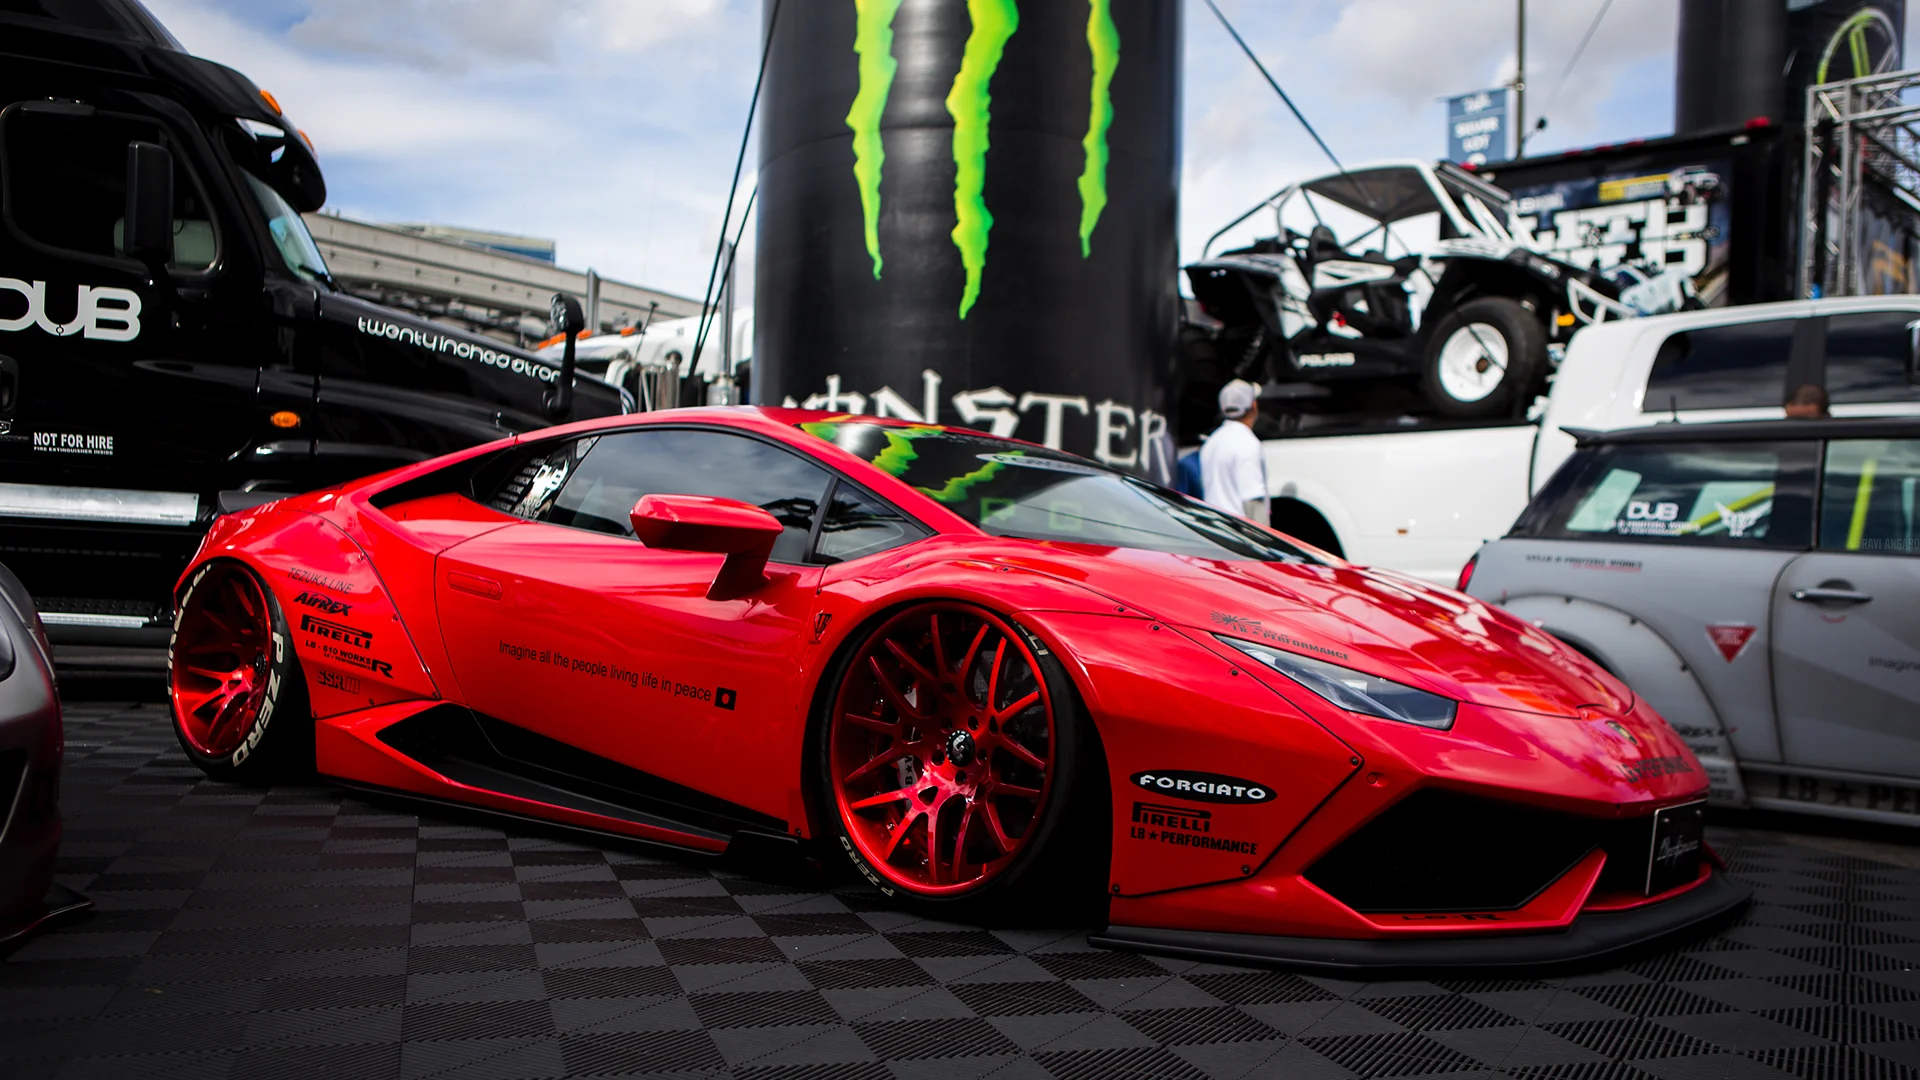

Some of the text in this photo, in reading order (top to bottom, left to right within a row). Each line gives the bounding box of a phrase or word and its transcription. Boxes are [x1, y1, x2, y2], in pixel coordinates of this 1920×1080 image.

[0, 276, 141, 342] DUB
[357, 316, 437, 351] twenty
[33, 432, 113, 450] NOT FOR HIRE
[1626, 501, 1679, 520] DUB
[287, 567, 354, 595] TEZUKA LINE
[300, 614, 373, 649] PIRELLI
[1262, 631, 1350, 661] PERFORMANCE
[305, 639, 317, 649] LB
[323, 645, 338, 656] 610
[340, 649, 371, 665] WORKS
[499, 640, 712, 702] Imagine all the people living life in peace
[1139, 774, 1267, 800] FORGIATO
[1132, 801, 1212, 832] PIRELLI
[1130, 826, 1258, 856] LB PERFORMANCE
